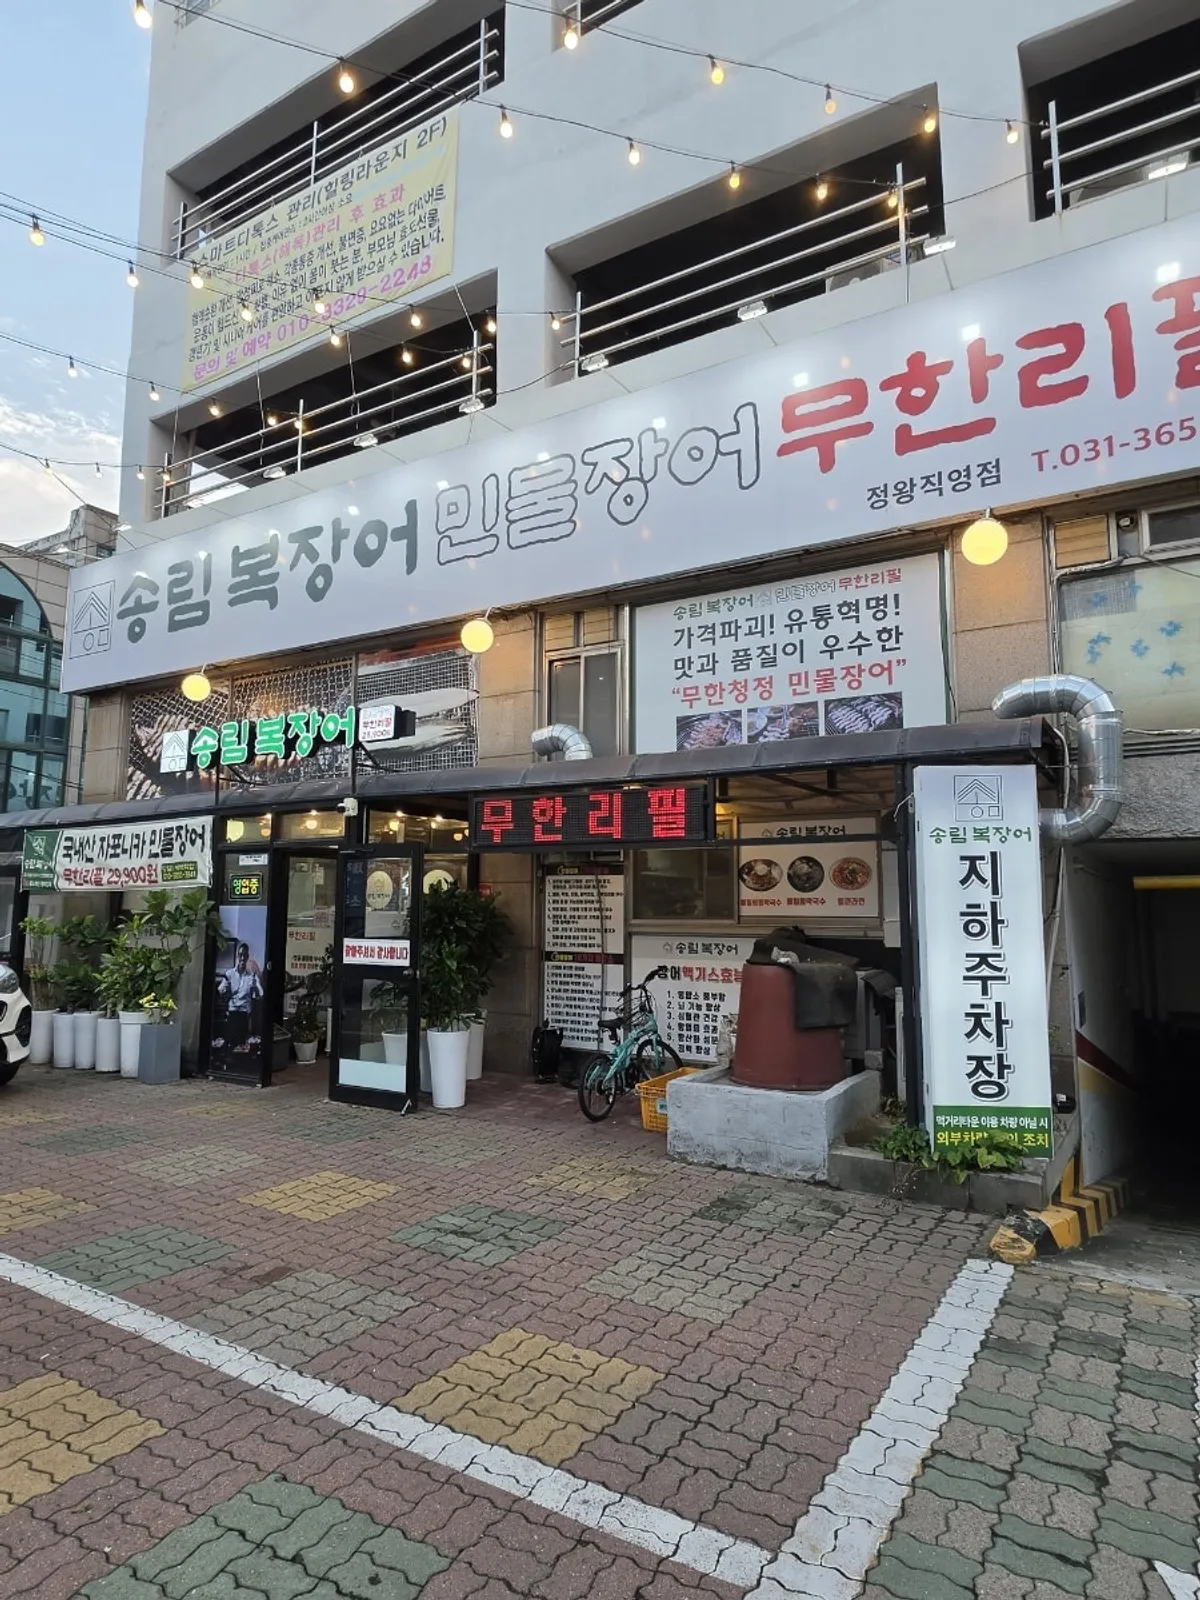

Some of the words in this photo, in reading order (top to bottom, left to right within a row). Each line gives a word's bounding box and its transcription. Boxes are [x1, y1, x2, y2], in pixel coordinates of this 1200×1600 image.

[200, 212, 279, 269] 스마트디톡스
[286, 138, 407, 222] 관리(힐링라운지
[416, 114, 447, 150] 2F)
[350, 202, 364, 224] 후
[372, 180, 405, 215] 효과
[309, 261, 327, 285] 몸이
[367, 227, 396, 257] 부모님
[387, 247, 399, 268] 수
[193, 355, 219, 382] 문의
[225, 347, 237, 368] 및
[242, 329, 272, 359] 예약
[1031, 416, 1197, 472] T.031-365
[435, 402, 760, 565] 민물장어
[866, 457, 1003, 511] 정왕직영점
[774, 579, 836, 602] 민물장어
[838, 568, 902, 592] 무한리필
[673, 613, 775, 649] 가격파괴!
[783, 593, 900, 633] 유통혁명!
[673, 652, 719, 681] 맛과
[730, 639, 805, 672] 품질이
[819, 624, 904, 660] 우수한
[62, 834, 96, 864] 국내산
[98, 831, 147, 862] 자포니카
[148, 823, 206, 859] 민물장어
[62, 867, 106, 887] 무한리필
[106, 863, 159, 888] 29,900원
[233, 878, 259, 895] 영업중
[377, 946, 408, 960] 감사합니다
[959, 850, 1013, 1099] 지하주차장
[936, 1115, 980, 1128] 먹거리타운
[981, 1116, 999, 1128] 이용
[1000, 1116, 1018, 1129] 차량
[1019, 1117, 1038, 1129] 아닐
[1039, 1117, 1048, 1129] 시
[1023, 1133, 1049, 1148] 조치
